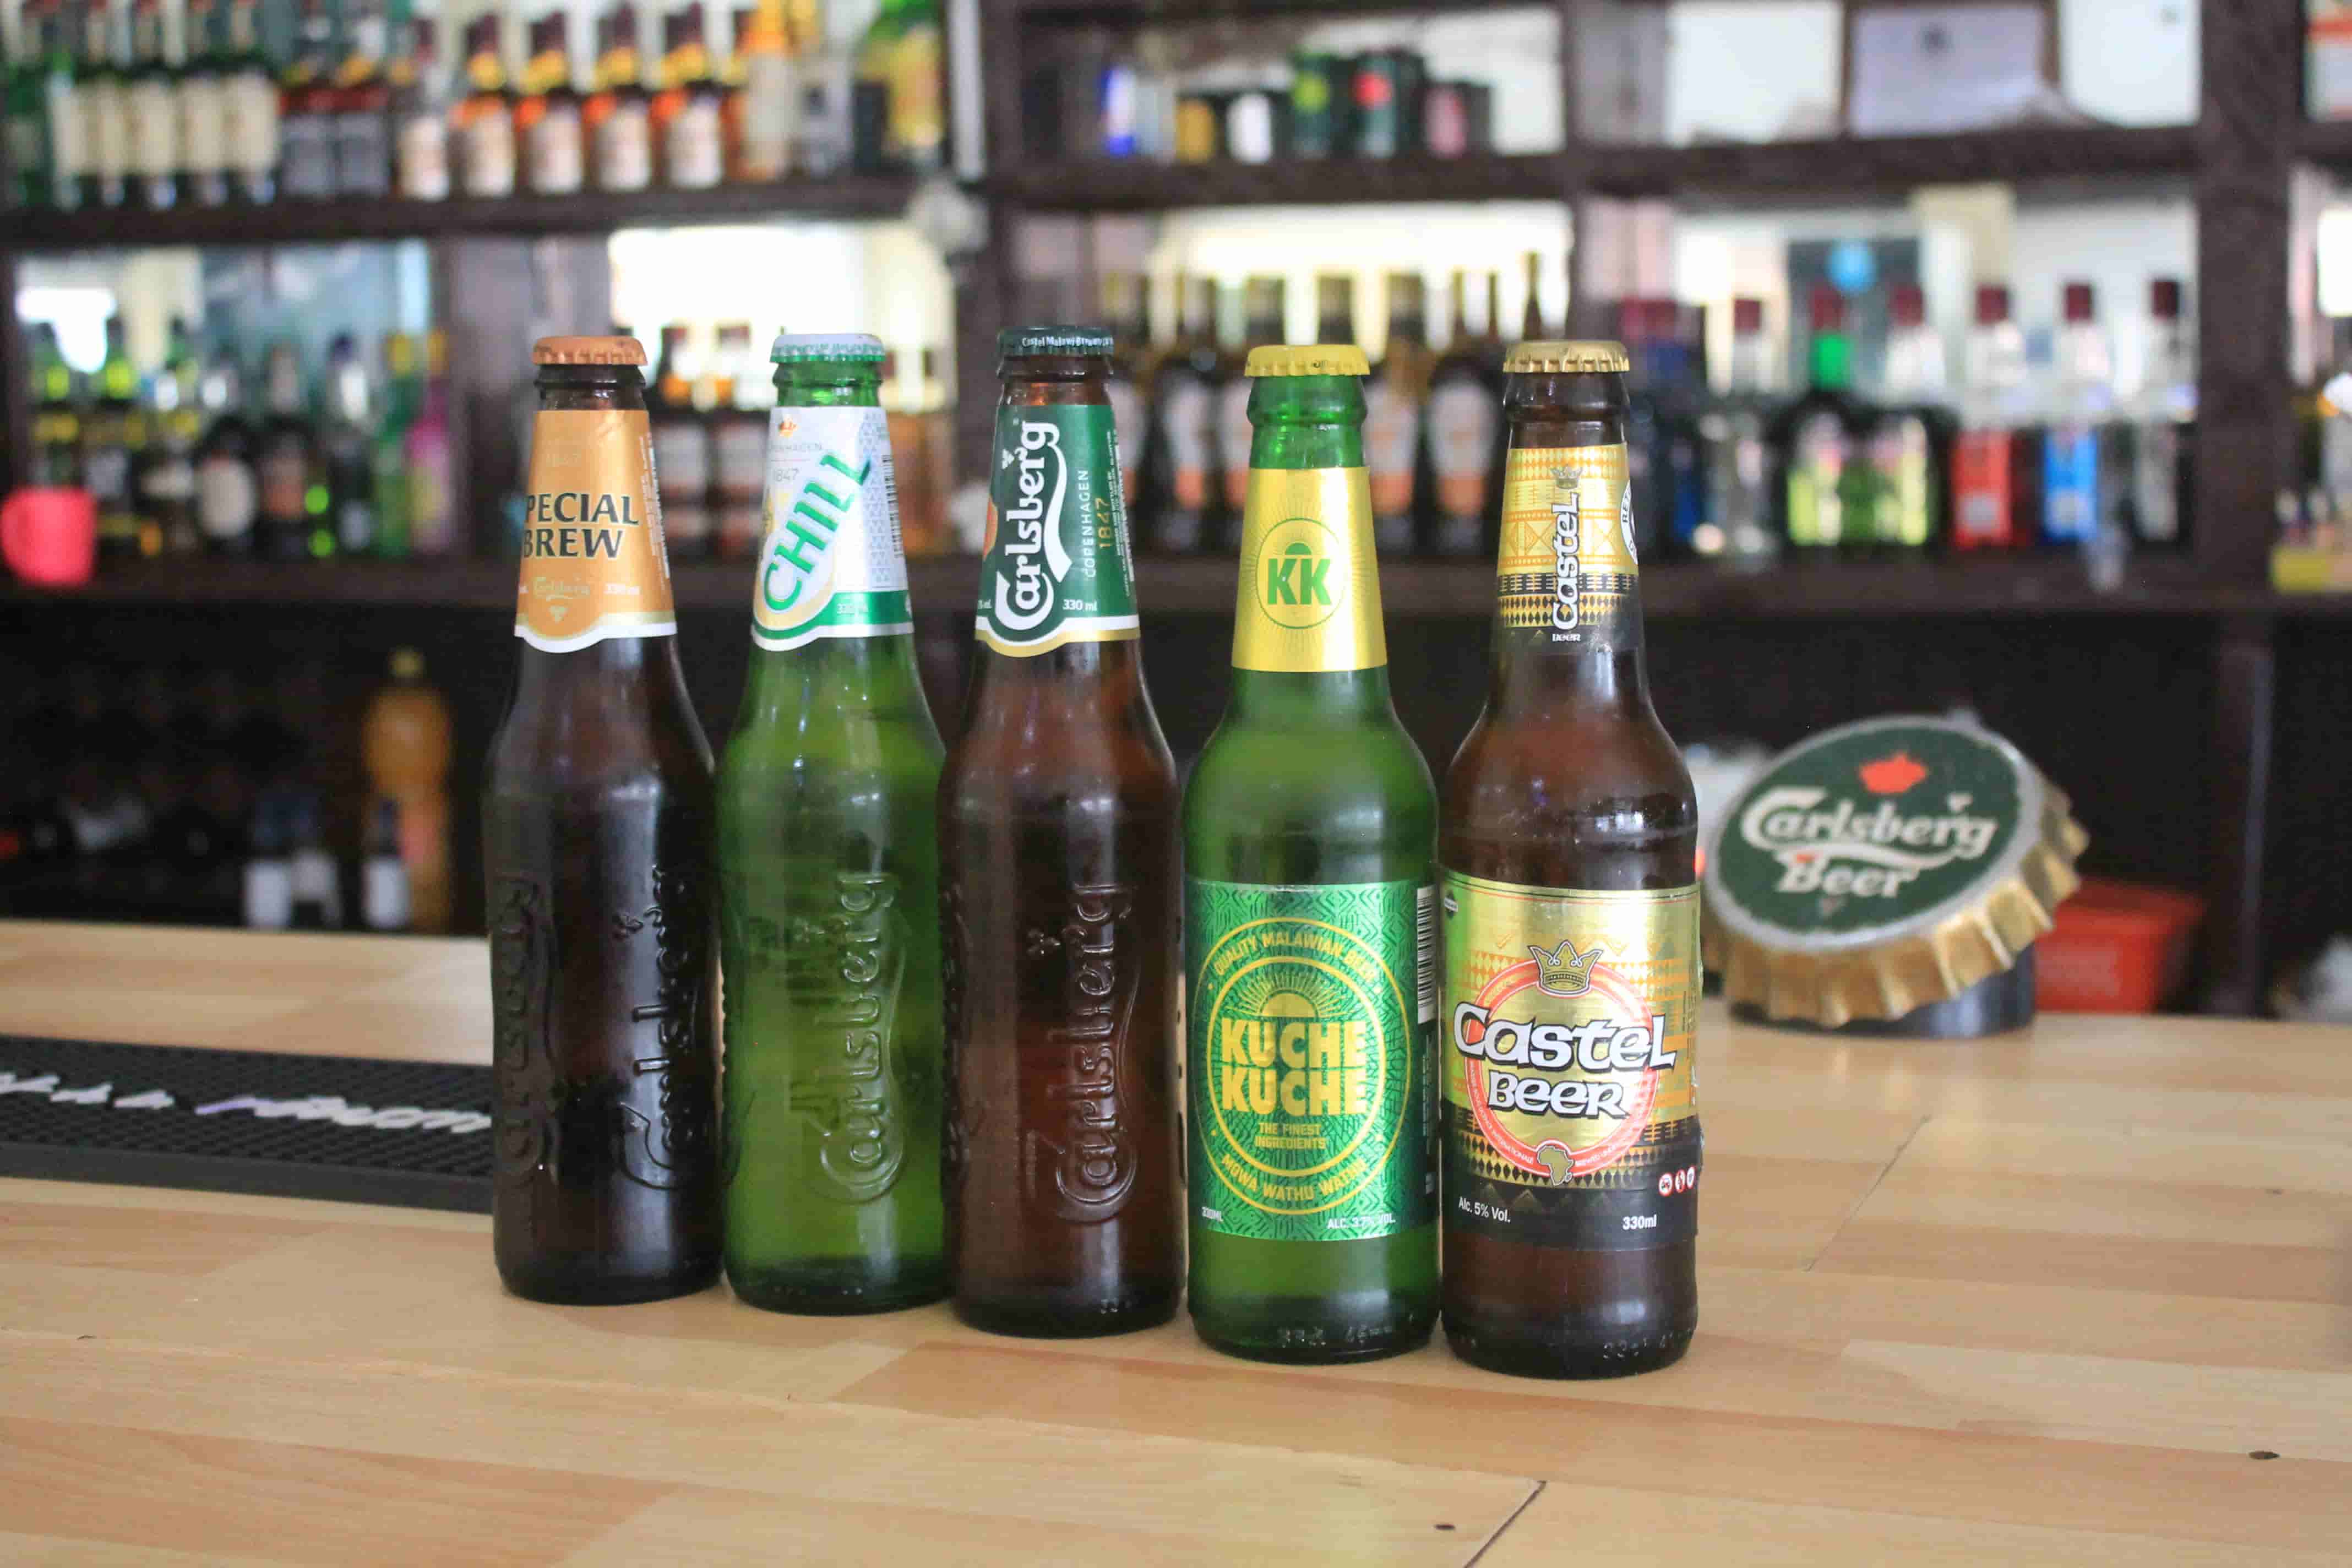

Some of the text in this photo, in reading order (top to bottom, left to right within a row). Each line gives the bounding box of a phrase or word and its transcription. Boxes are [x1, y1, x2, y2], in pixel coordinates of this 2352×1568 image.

[524, 528, 623, 558] BREW
[764, 453, 871, 611] CHILL
[994, 421, 1072, 630] Carlsberg
[1077, 470, 1097, 578] COPENHAGEN
[1097, 497, 1111, 549] 1847
[1063, 598, 1083, 611] 330
[1267, 558, 1331, 605] KK
[1741, 786, 1997, 869] Carlsberg
[1774, 851, 1922, 899] Beer
[1213, 935, 1257, 976] QUALITY
[1261, 932, 1343, 957] MALAWIAN
[1222, 1017, 1366, 1067] KUCHE
[1222, 1066, 1366, 1116] KUCHE
[1254, 1136, 1327, 1150] INGREDIENTS
[1259, 1123, 1321, 1136] THE FINEST
[1222, 1153, 1258, 1193] MOWA
[1263, 1182, 1315, 1201] WATHU
[1458, 1196, 1511, 1223] Alc. 5% Vol.
[1622, 1214, 1657, 1231] 330ml
